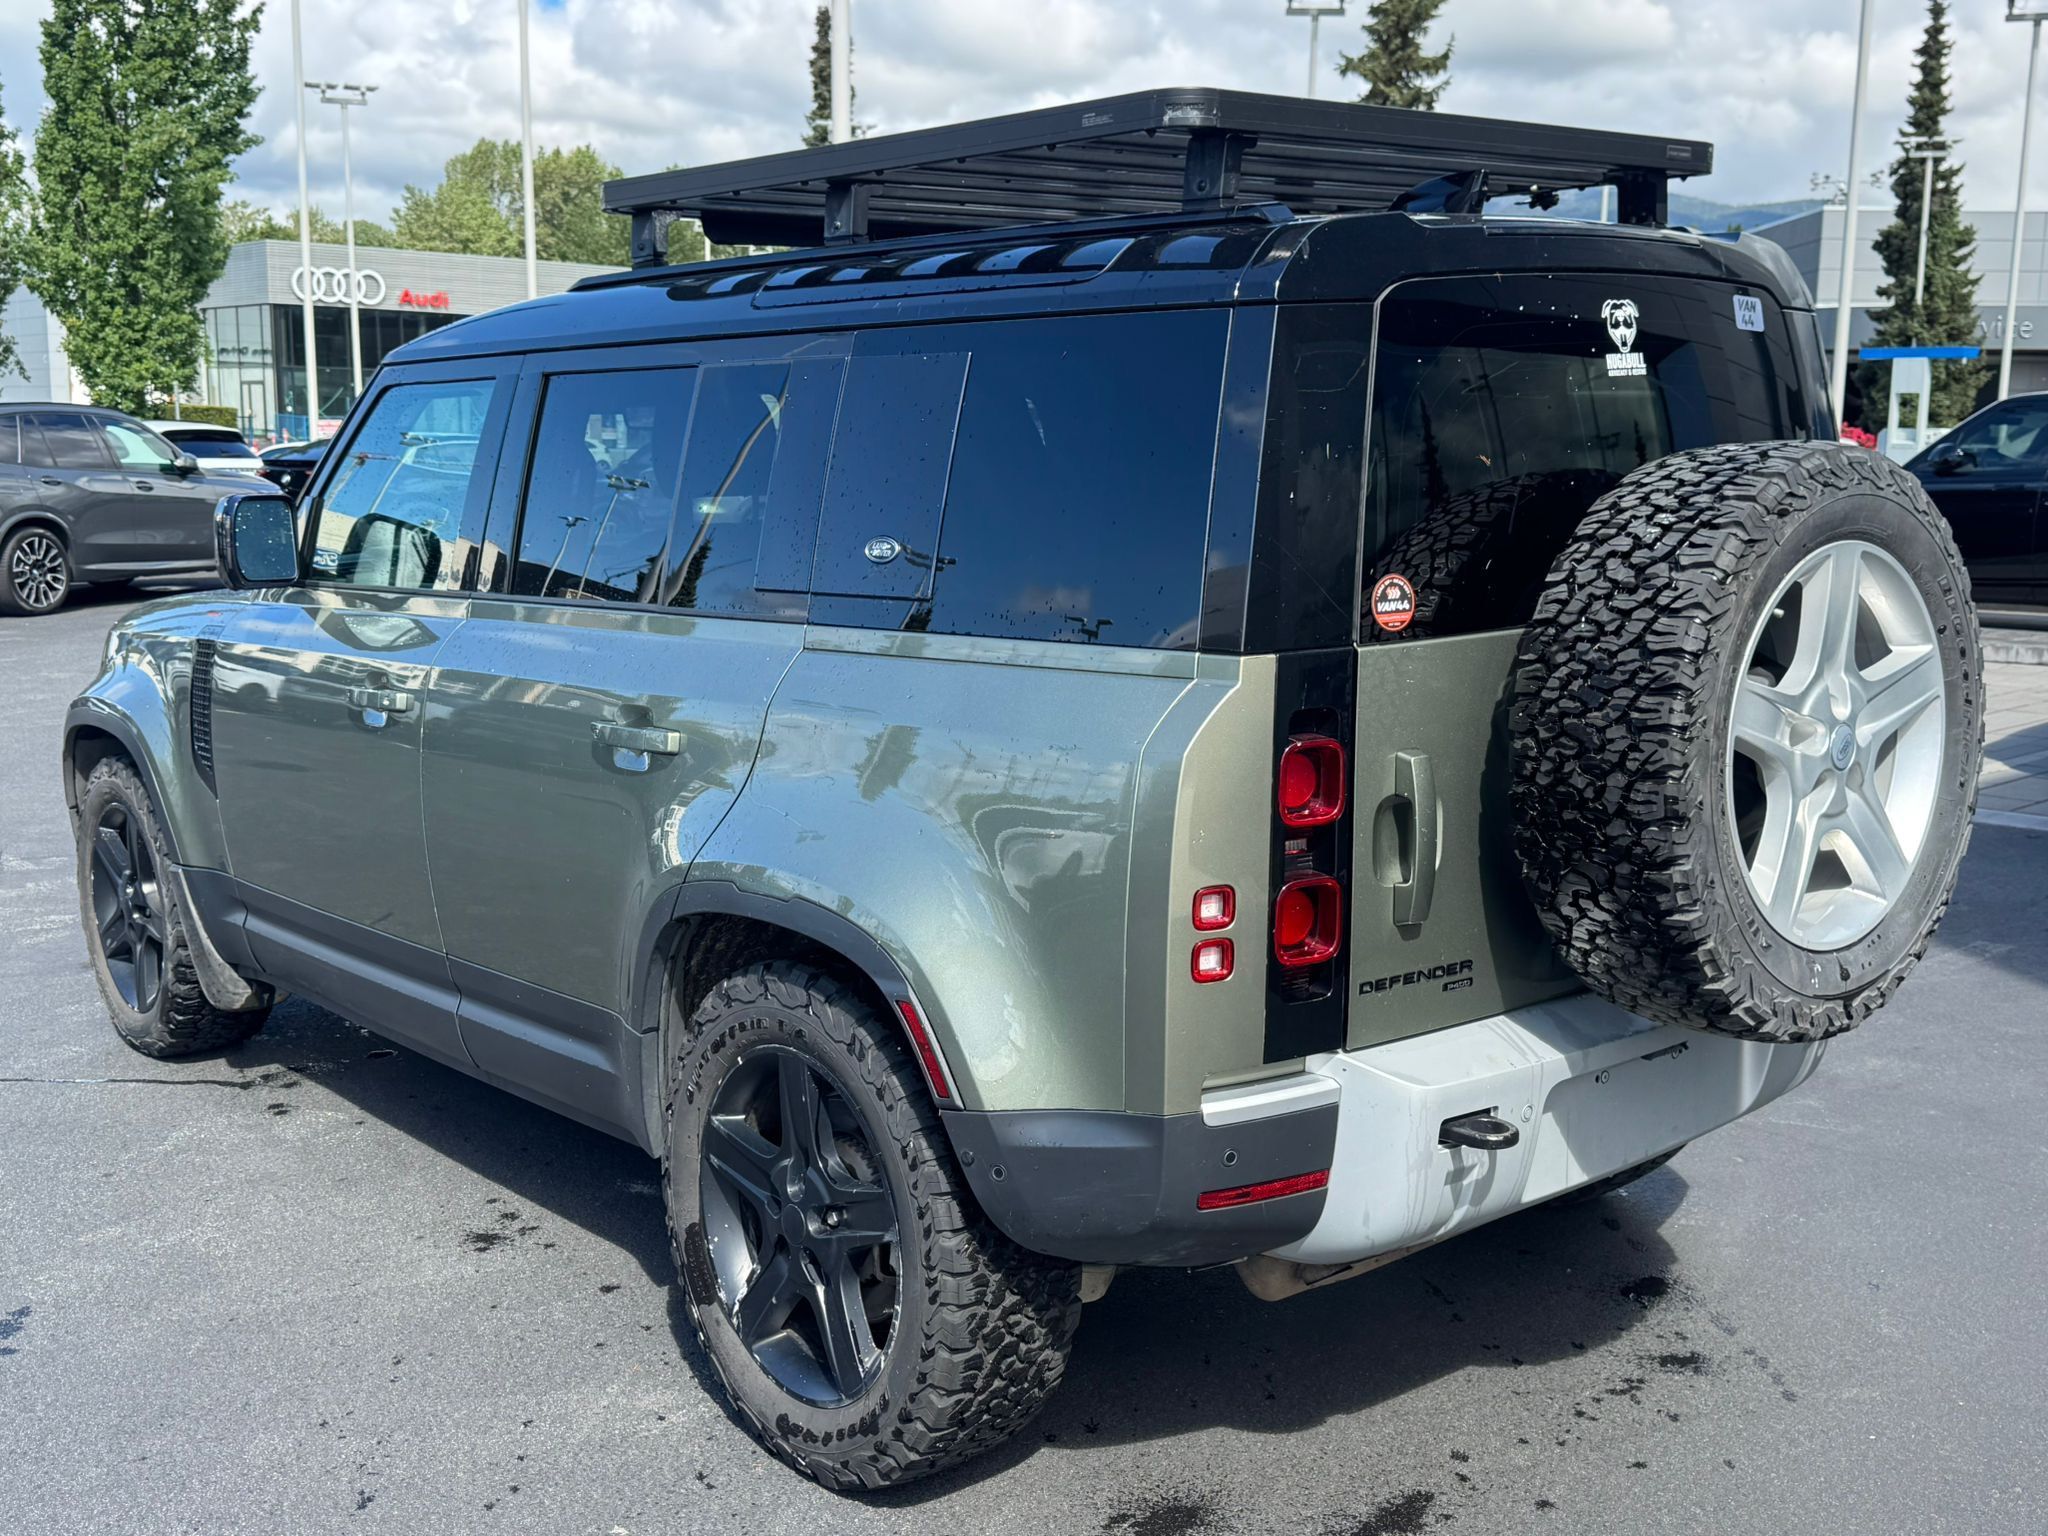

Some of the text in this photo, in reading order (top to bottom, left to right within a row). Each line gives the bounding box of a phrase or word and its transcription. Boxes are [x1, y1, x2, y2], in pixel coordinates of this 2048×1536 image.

[399, 288, 450, 309] Audi
[1736, 297, 1757, 314] VAN
[1741, 314, 1756, 328] 44
[1358, 959, 1474, 995] DEFENDER
